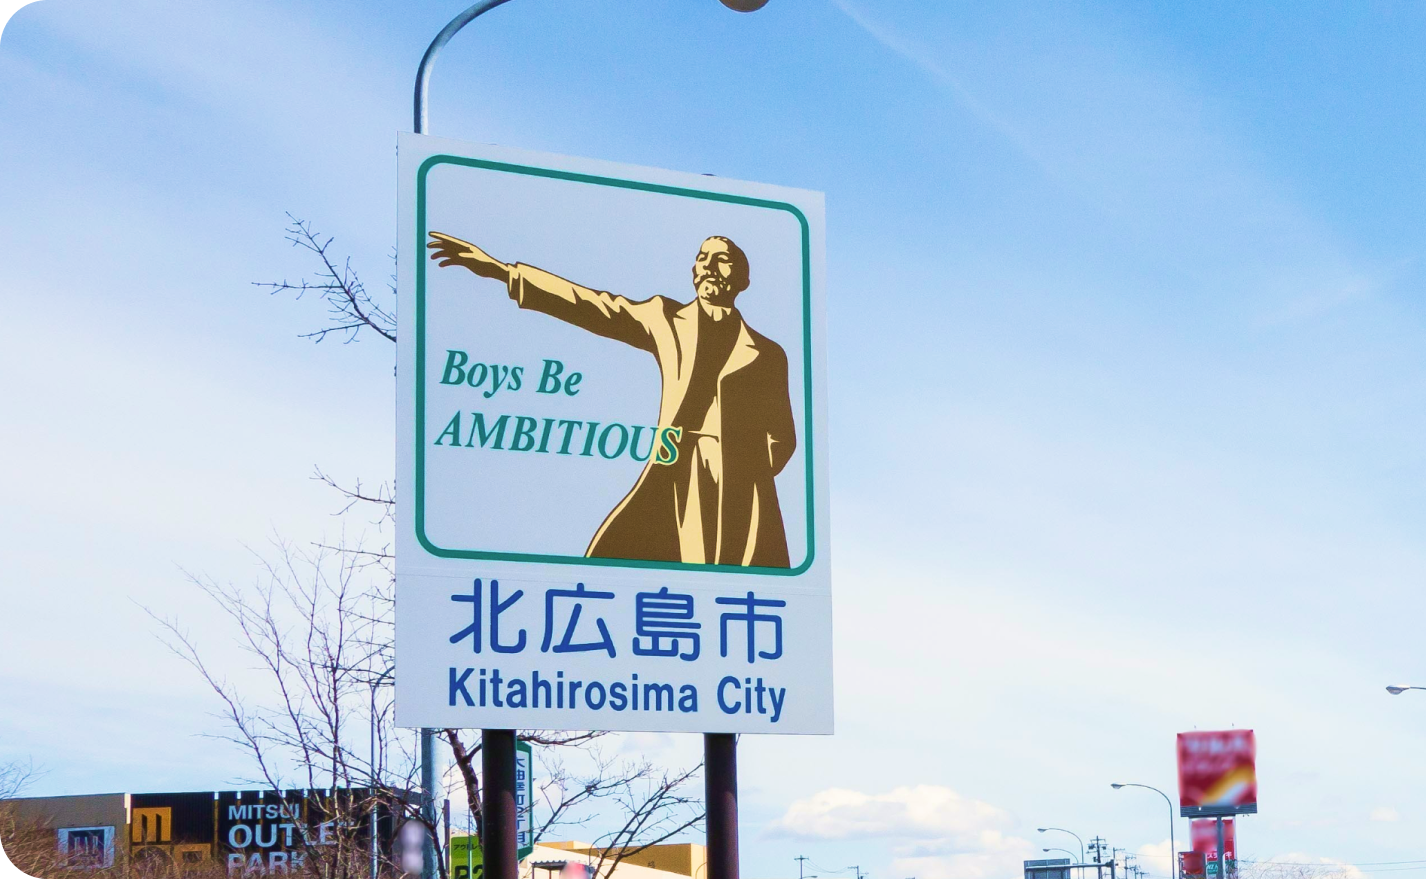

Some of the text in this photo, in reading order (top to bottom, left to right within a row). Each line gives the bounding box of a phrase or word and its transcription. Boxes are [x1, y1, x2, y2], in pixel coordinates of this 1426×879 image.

[440, 350, 582, 398] Boys Be
[434, 410, 681, 463] AMBITIOUS
[449, 578, 787, 663] 北広島市
[449, 667, 786, 722] Kitahirosima City
